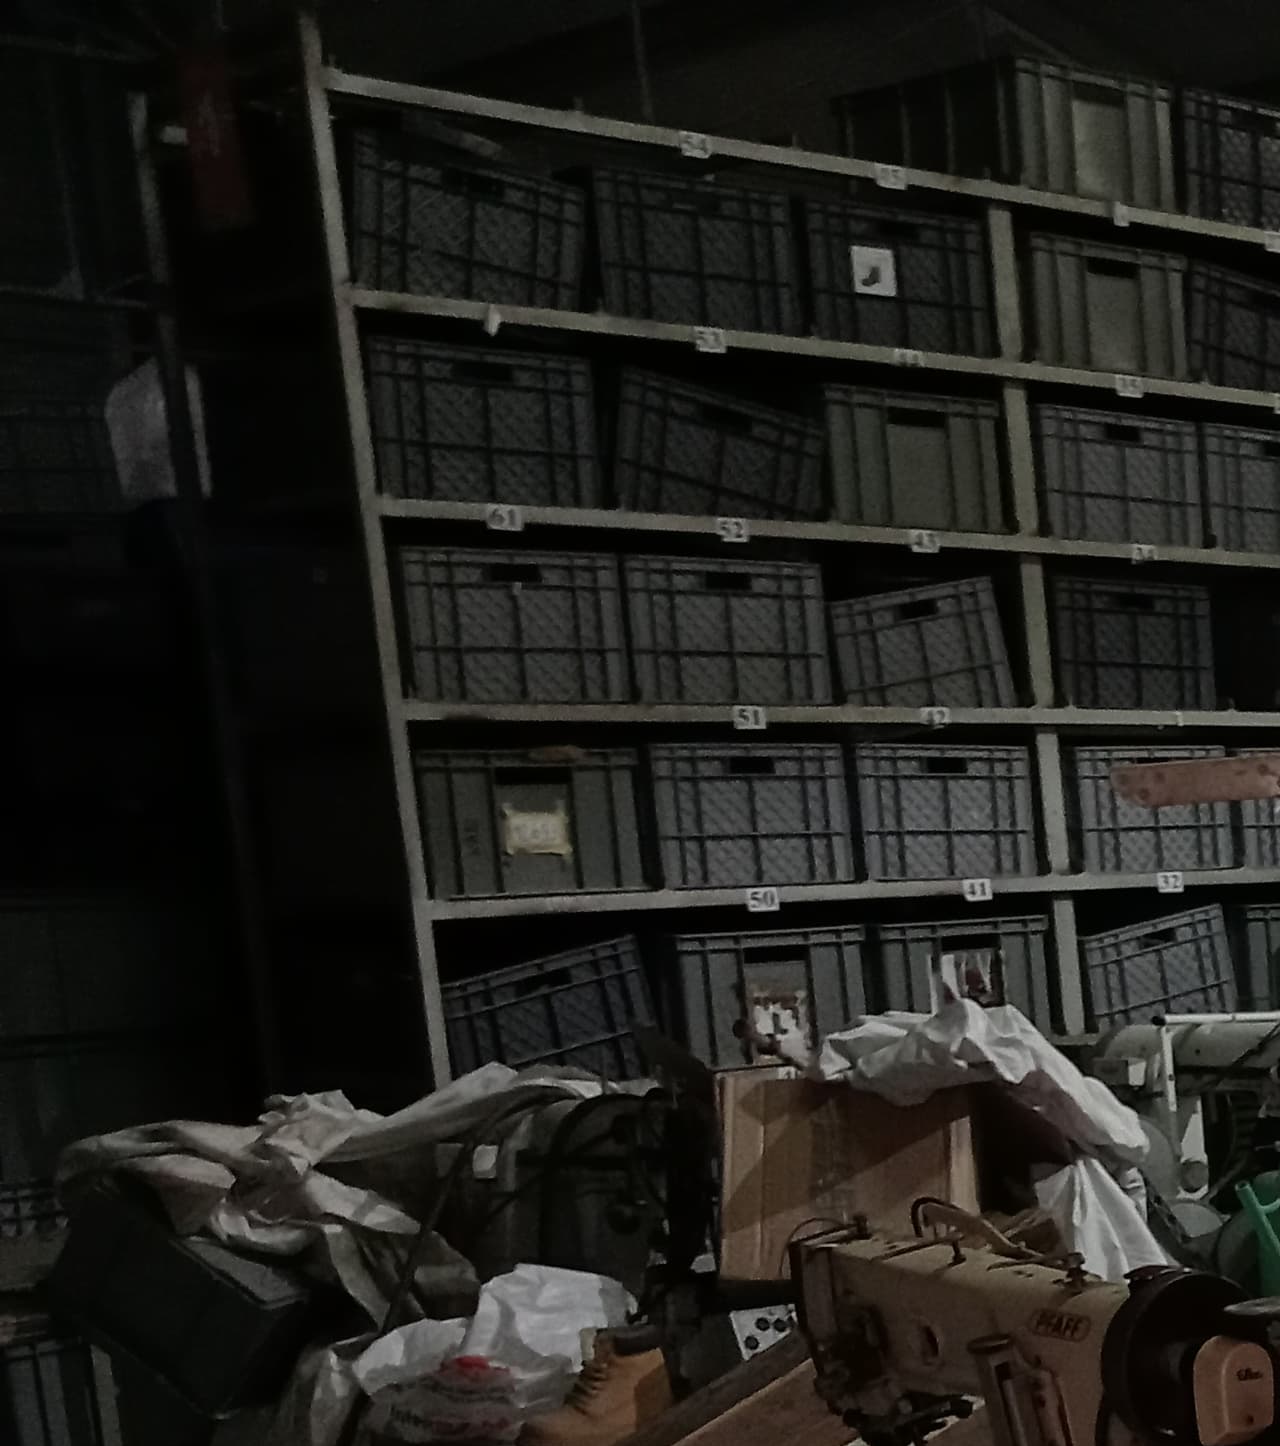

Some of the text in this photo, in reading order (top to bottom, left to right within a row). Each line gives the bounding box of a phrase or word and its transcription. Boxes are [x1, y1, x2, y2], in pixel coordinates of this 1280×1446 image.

[487, 508, 517, 528] 61
[720, 520, 744, 538] 52
[738, 707, 761, 727] 51
[967, 881, 988, 898] 41
[1160, 873, 1181, 890] 32
[750, 890, 775, 909] 50
